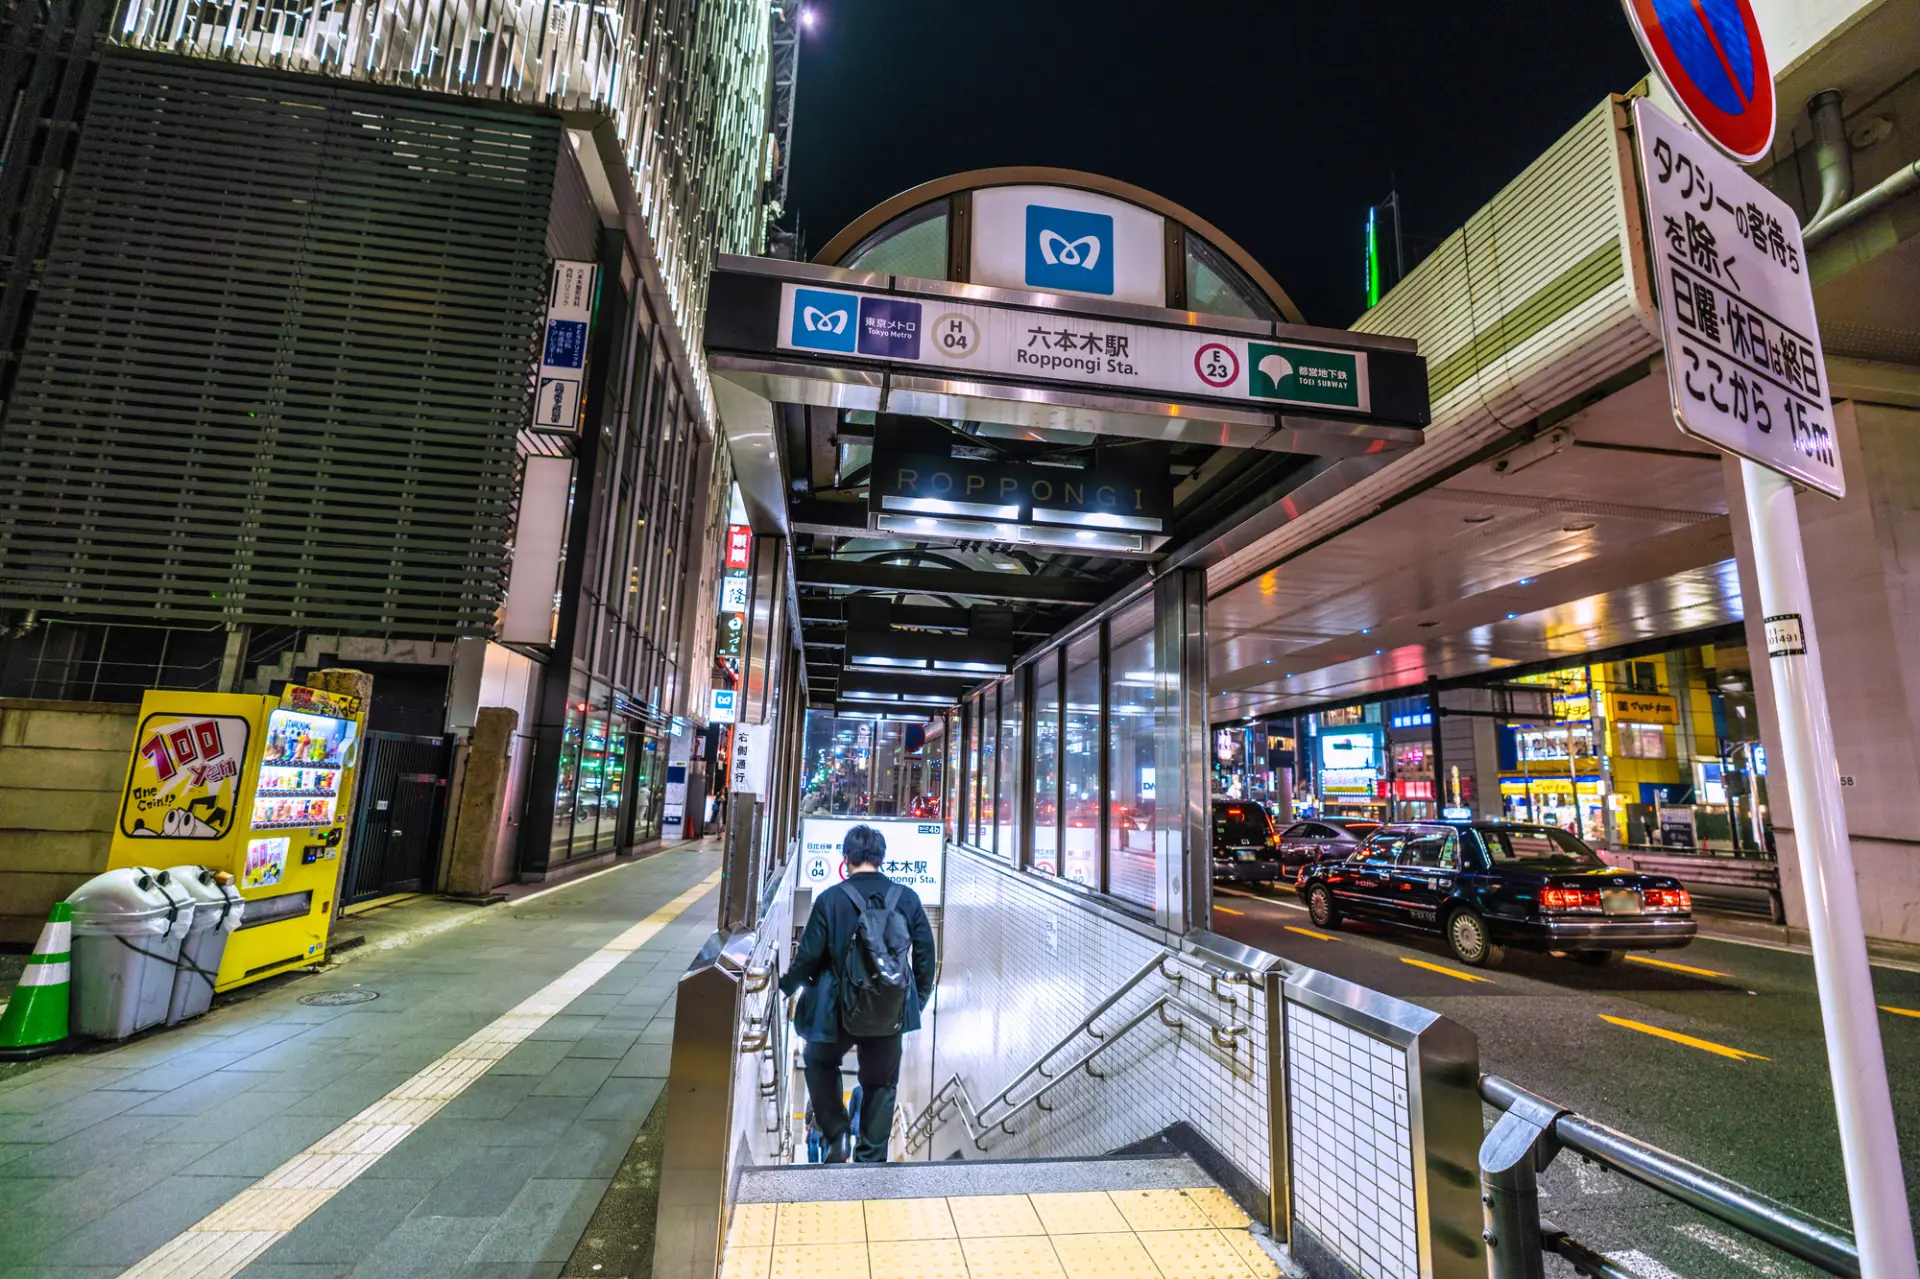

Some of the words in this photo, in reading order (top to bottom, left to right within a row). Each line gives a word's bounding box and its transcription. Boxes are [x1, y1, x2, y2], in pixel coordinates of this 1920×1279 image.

[1653, 136, 1800, 275] タクシーの客待ち
[1664, 211, 1741, 292] を除く
[865, 316, 916, 331] 東京メトロ
[950, 320, 962, 333] H
[868, 327, 889, 337] Tokyo
[890, 330, 912, 339] Metro
[1671, 267, 1821, 398] 日曜・休日は終日
[943, 334, 968, 349] 04
[1028, 326, 1128, 358] 六本木駅
[1017, 349, 1101, 374] Roppongi
[1107, 359, 1138, 376] Sta.
[1213, 351, 1221, 362] E
[1207, 363, 1228, 378] 23
[1298, 366, 1348, 380] 都営地下鉄
[1299, 378, 1315, 387] TOEI
[1317, 379, 1348, 389] SUBWAY
[1682, 345, 1772, 434] ここから
[1784, 397, 1834, 467] 15m
[897, 467, 1143, 510] ROPPONGI
[1768, 633, 1798, 645] 01491
[140, 718, 225, 783] 100
[735, 732, 749, 783] 右側通行
[1840, 777, 1854, 786] 58
[133, 786, 158, 800] One
[136, 793, 176, 812] Coin!?
[929, 826, 940, 834] 4b
[811, 869, 824, 877] 04
[920, 875, 937, 884] Sta.
